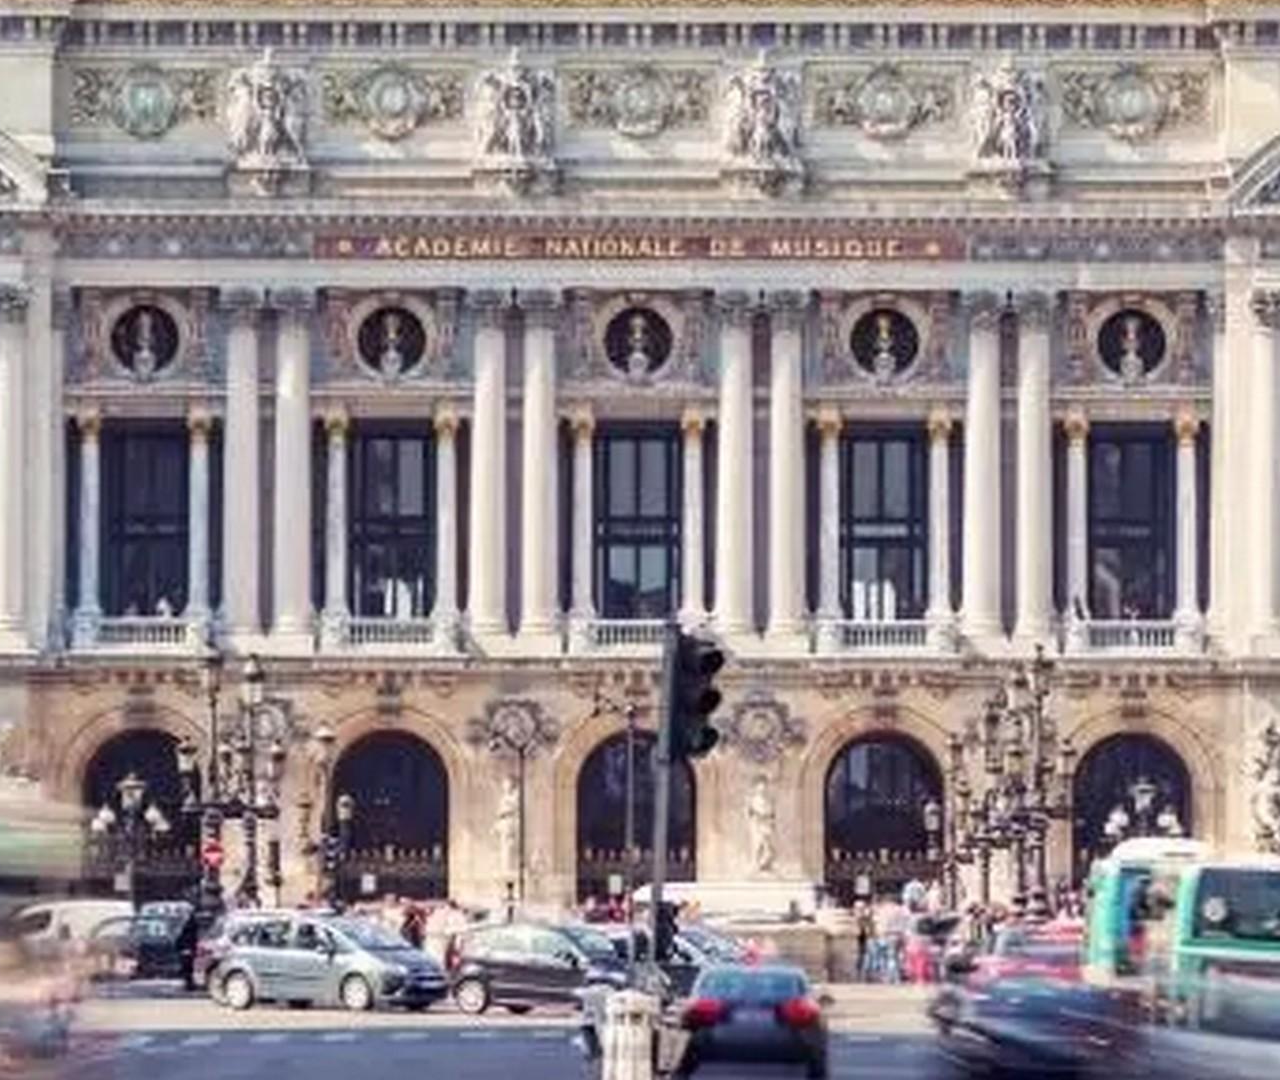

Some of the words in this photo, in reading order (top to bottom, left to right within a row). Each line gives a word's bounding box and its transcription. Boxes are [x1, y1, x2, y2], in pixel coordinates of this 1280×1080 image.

[545, 235, 686, 257] NATIONALE
[709, 237, 746, 257] DE
[771, 237, 903, 258] MUSIQUE
